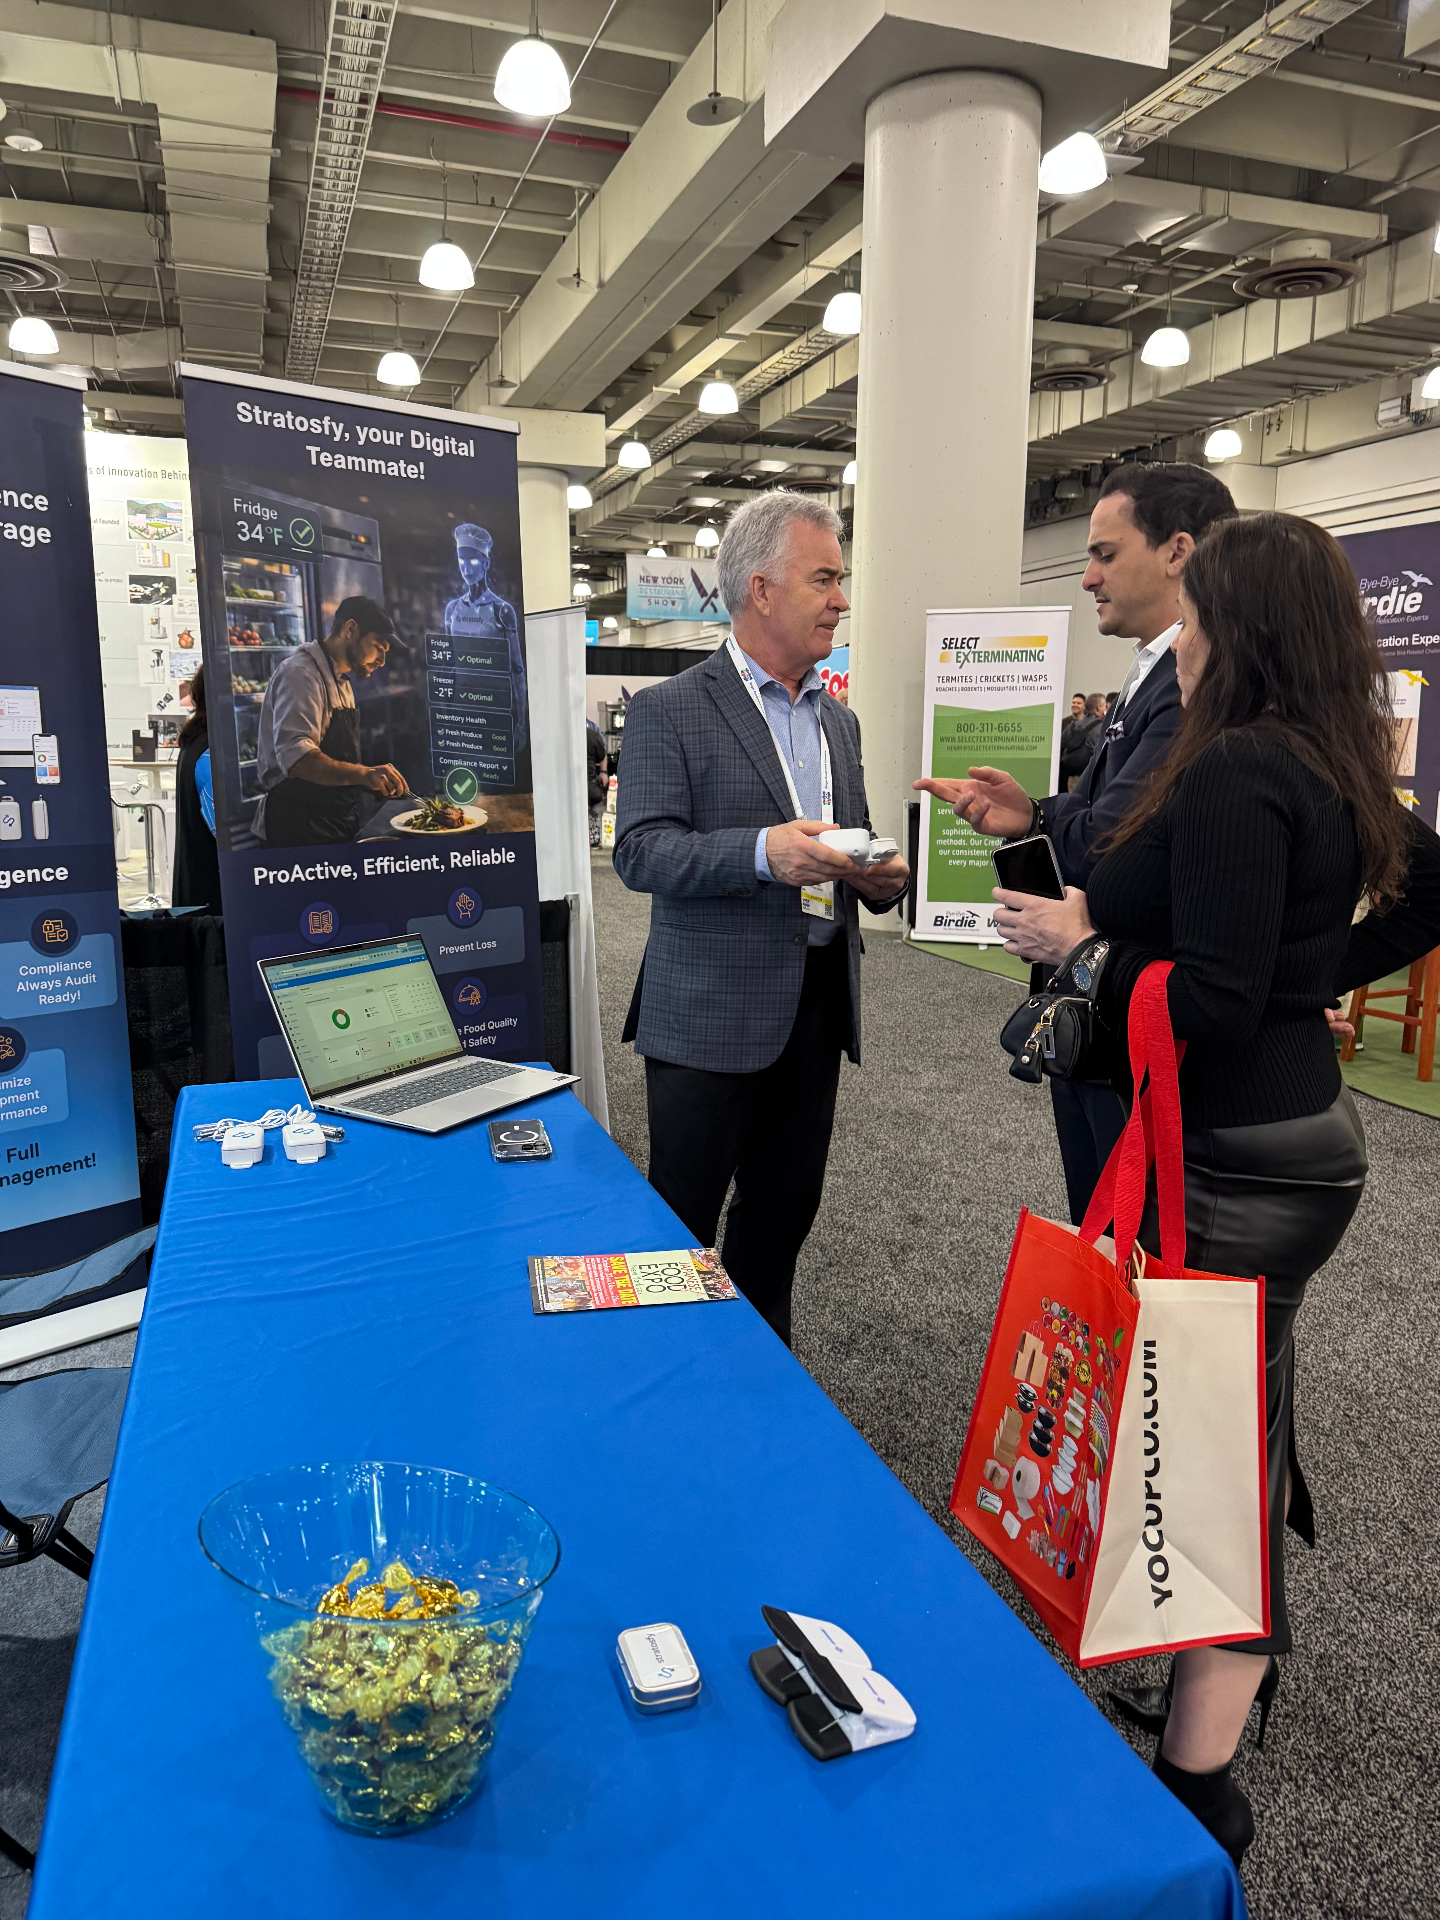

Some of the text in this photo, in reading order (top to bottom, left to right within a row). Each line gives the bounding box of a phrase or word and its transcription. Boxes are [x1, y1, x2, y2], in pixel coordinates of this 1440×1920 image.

[236, 402, 475, 458] Stratosfy, your Digital
[306, 445, 425, 480] Teammate!
[96, 465, 105, 476] of
[108, 466, 158, 479] Innovation
[161, 469, 189, 481] Behin
[0, 489, 49, 512] nce
[233, 498, 278, 520] Fridge
[0, 522, 52, 548] age
[236, 521, 284, 545] 34°F
[639, 575, 685, 585] NEW YORK
[1360, 575, 1400, 592] Bye-Bye
[639, 587, 685, 596] RESTAURANT
[647, 598, 677, 606] SHOW
[1406, 614, 1429, 623] Experts
[430, 639, 450, 648] Fridge
[941, 636, 980, 650] SELECT
[431, 650, 493, 665] 34°F Optimal
[955, 649, 1045, 669] EXTERMINATING
[432, 676, 454, 685] Freezer
[936, 674, 1048, 684] TERMITES CRICKETS WASPS
[467, 692, 493, 702] Optimal
[435, 712, 487, 725] Inventory Health
[445, 728, 506, 741] Fresh Produce Good
[956, 722, 1022, 733] 800-311-6655
[446, 739, 461, 748] Fresh
[461, 742, 483, 750] Produce
[939, 735, 1046, 743] WWW.SELECTEXTERMINATING.COM
[439, 756, 500, 771] Compliance Report
[482, 772, 500, 781] Ready
[942, 828, 979, 836] sophistica
[936, 838, 968, 846] methods.
[969, 838, 982, 846] Our
[951, 849, 988, 857] consistent
[253, 847, 516, 886] ProActive, Efficient, Reliable
[948, 860, 967, 868] every
[968, 860, 989, 868] major
[932, 915, 977, 928] Birdie
[439, 939, 497, 956] Prevent Loss
[19, 960, 92, 978] Compliance
[16, 973, 97, 993] Always Audit
[38, 990, 82, 1006] Ready!
[463, 1022, 486, 1035] Food
[487, 1017, 518, 1030] Quality
[468, 1035, 497, 1048] Safety
[6, 1142, 39, 1164] Full
[609, 1256, 628, 1274] SAVE
[614, 1275, 632, 1288] THE
[638, 1263, 667, 1294] EXPO
[658, 1262, 687, 1292] FOOD
[679, 1261, 702, 1291] JAPANESE
[618, 1288, 638, 1305] DATE
[647, 1633, 665, 1664] stratosfy
